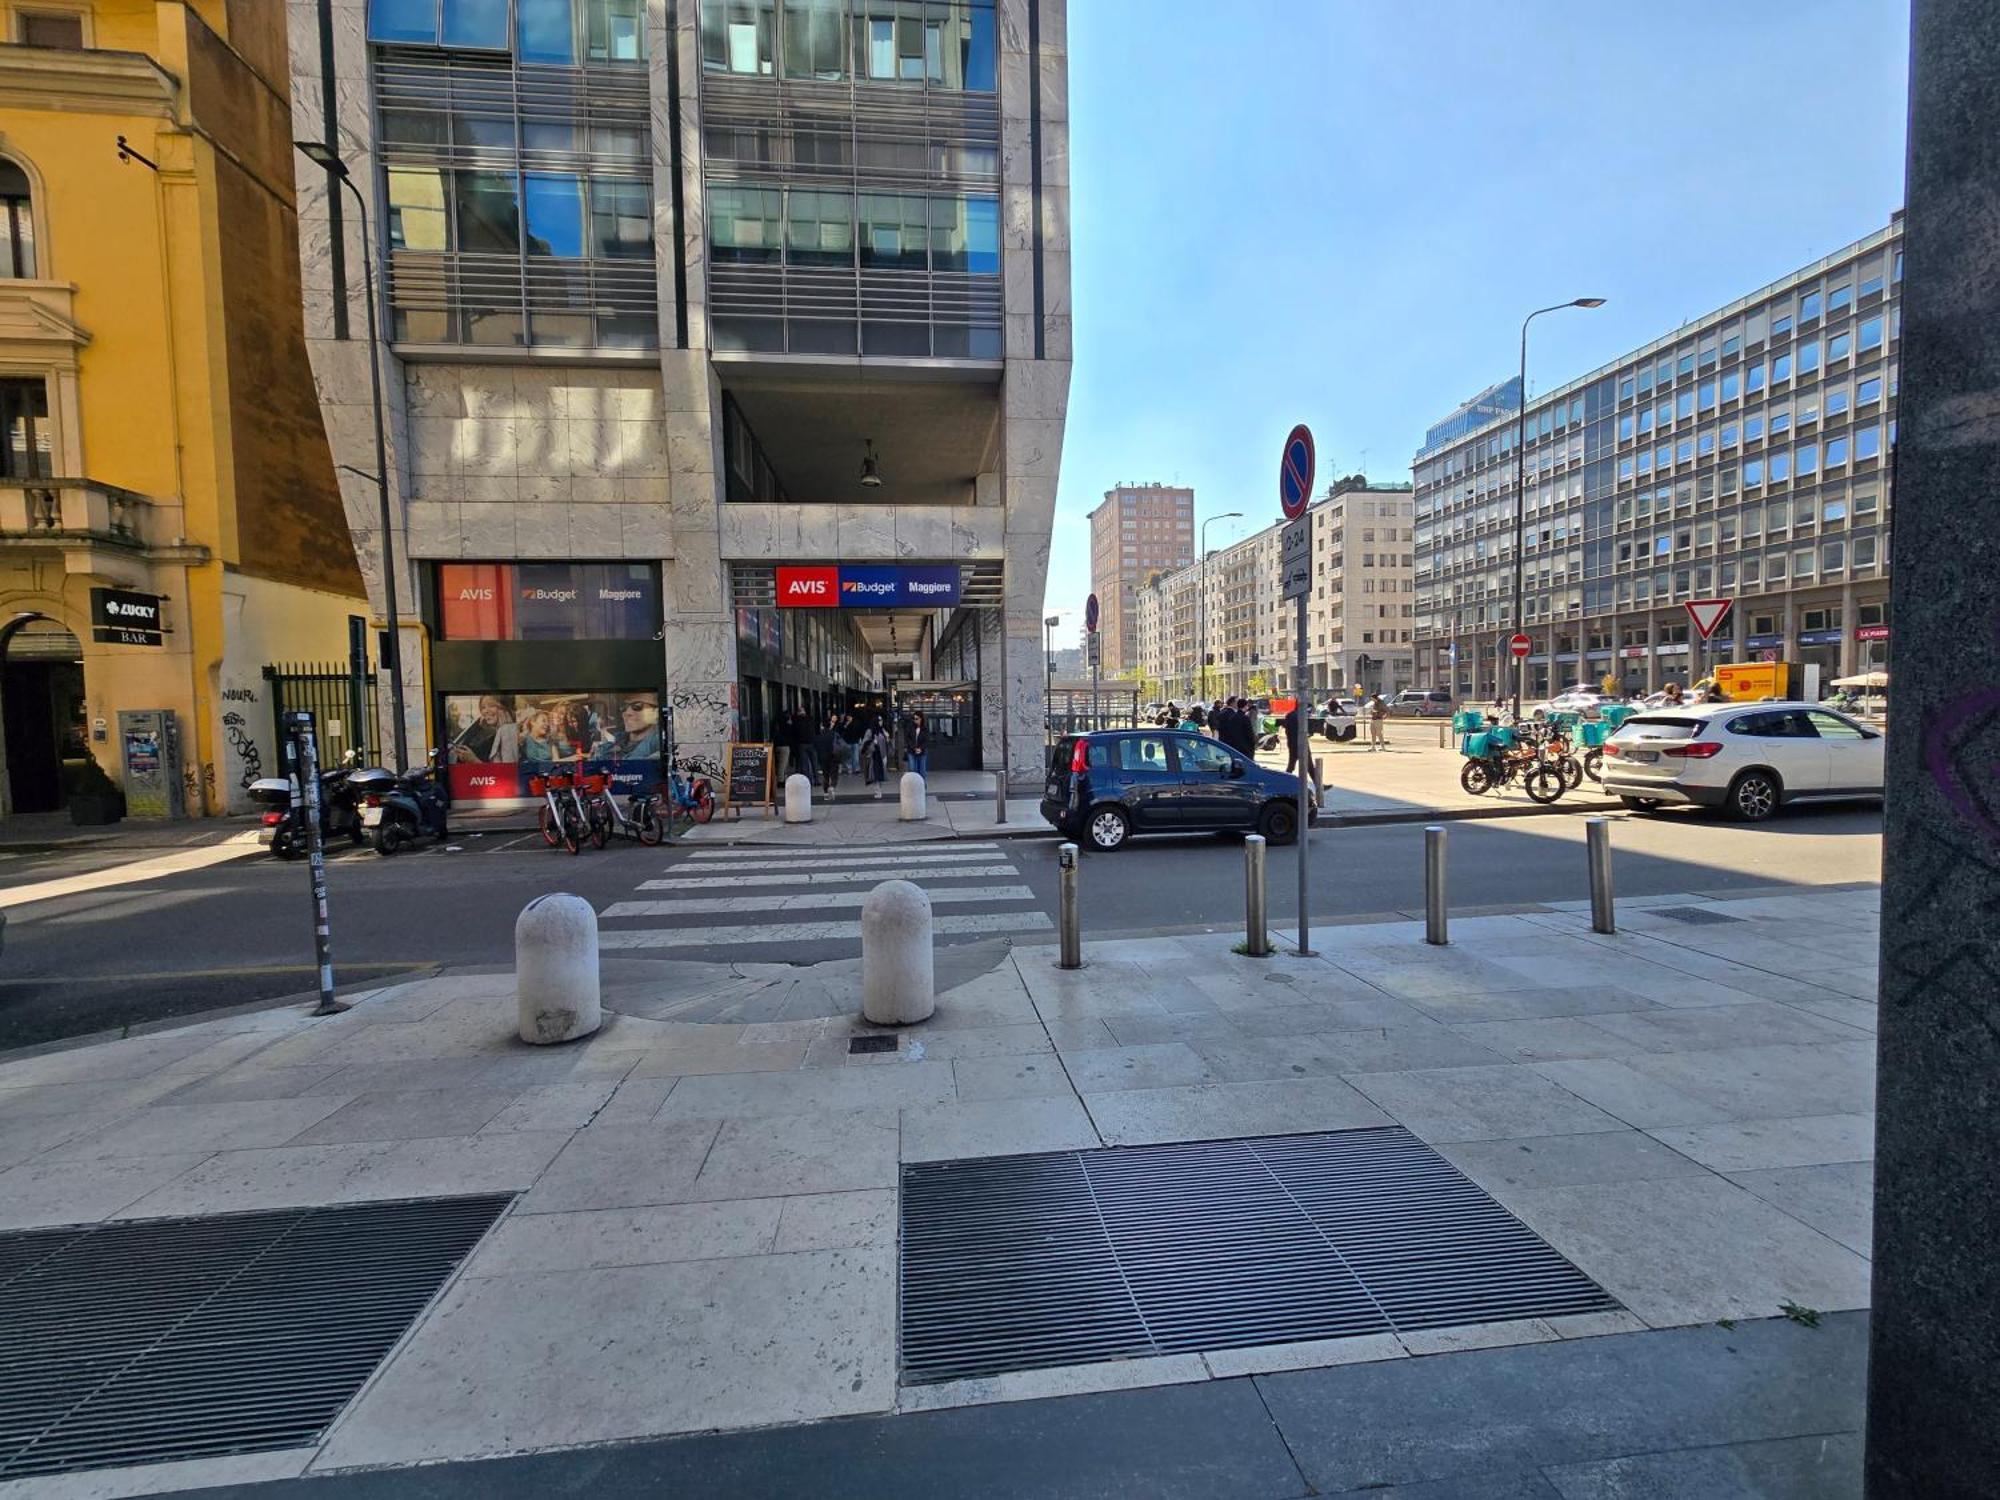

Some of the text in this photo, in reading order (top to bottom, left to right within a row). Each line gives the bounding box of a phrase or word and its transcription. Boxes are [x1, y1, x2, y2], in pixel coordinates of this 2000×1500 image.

[788, 581, 951, 595] AVIS Budget Maggiore
[460, 589, 641, 602] AVIS Budget Maggiore
[120, 603, 155, 618] LUCKY
[121, 631, 147, 643] BAR
[470, 776, 496, 786] AVIS
